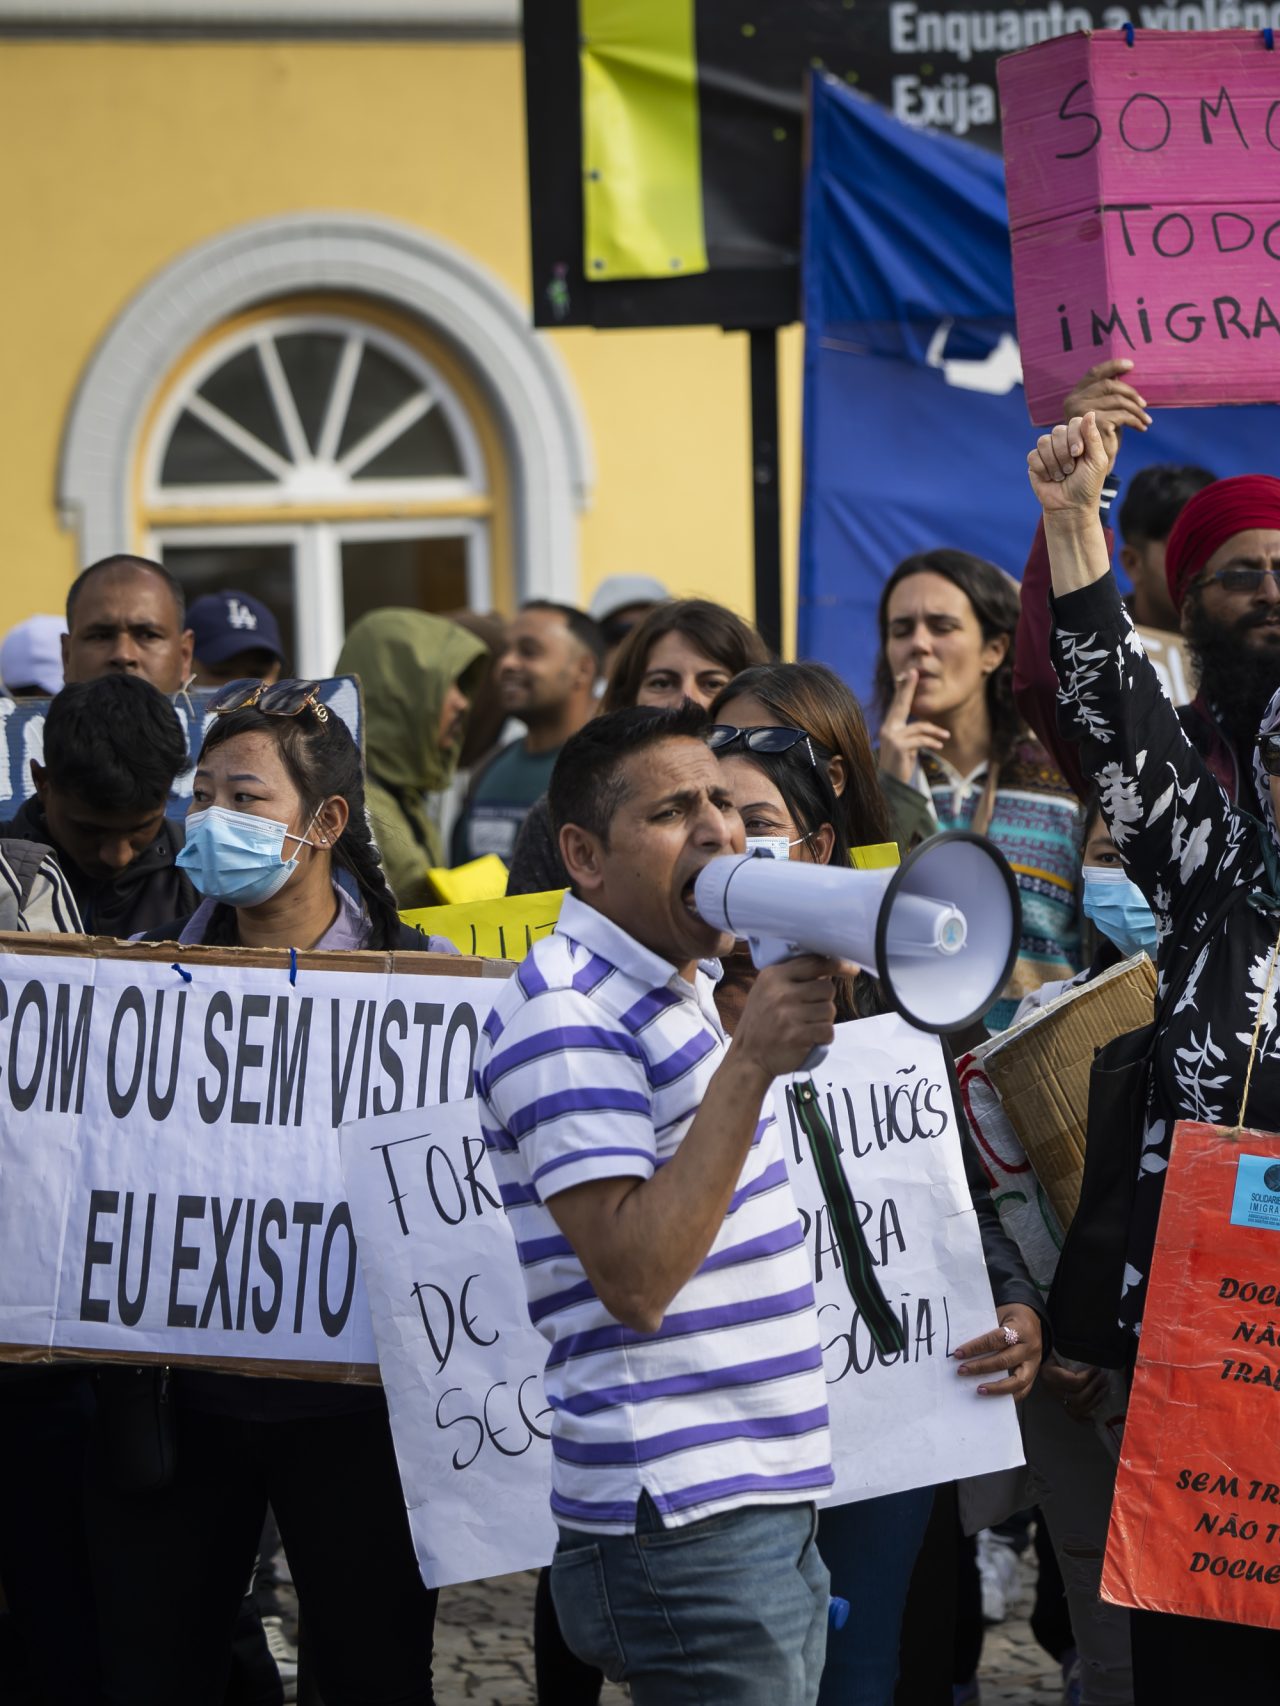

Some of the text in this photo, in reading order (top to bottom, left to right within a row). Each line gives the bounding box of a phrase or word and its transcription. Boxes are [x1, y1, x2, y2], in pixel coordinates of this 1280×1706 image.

[889, 2, 1091, 57] Enquanto
[892, 74, 995, 134] Exija
[0, 977, 480, 1129] OM OU SEM VISTO
[80, 1189, 357, 1338] EU EXISTO
[410, 1274, 499, 1376] DE
[1176, 1468, 1239, 1498] SEM
[1194, 1512, 1258, 1541] NÃO
